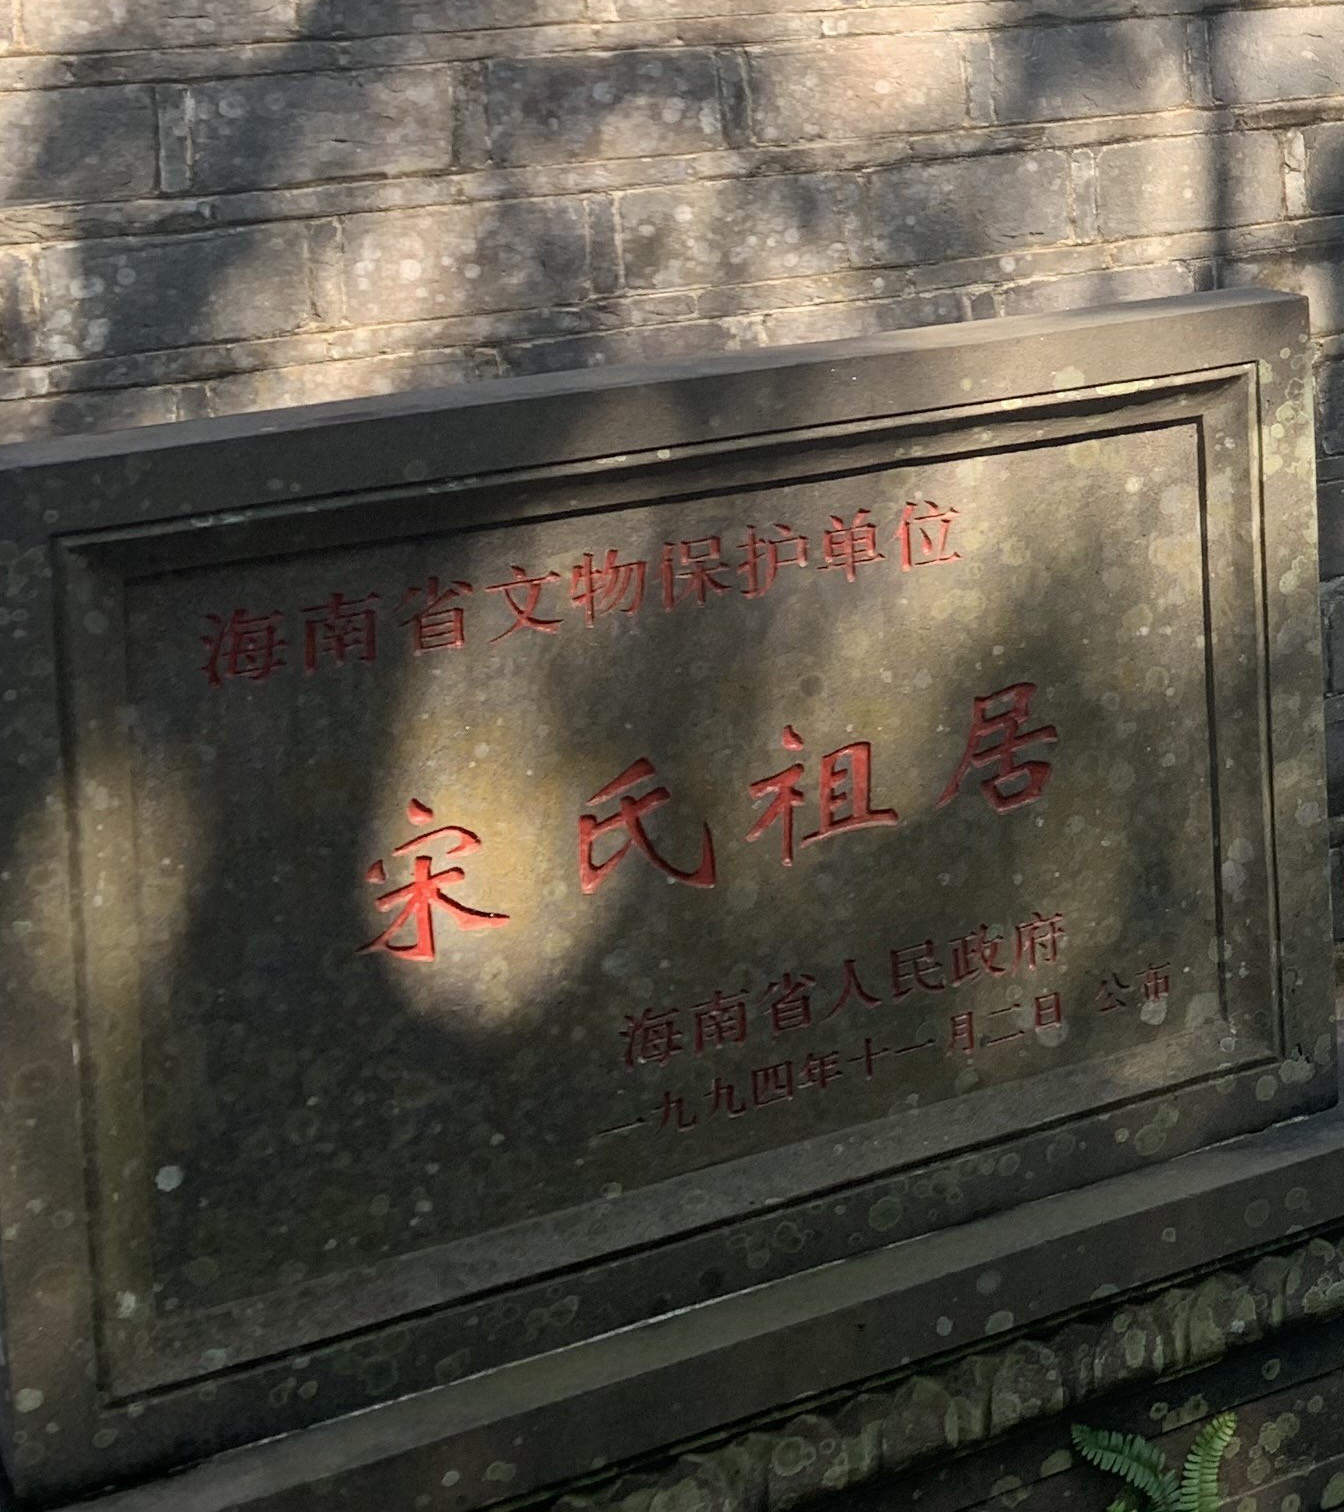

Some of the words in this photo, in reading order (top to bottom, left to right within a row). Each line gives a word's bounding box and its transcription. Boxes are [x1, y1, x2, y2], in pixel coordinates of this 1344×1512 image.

[200, 500, 962, 686] 海南省文物保护单位
[357, 682, 1061, 962] 宋氏祖居
[599, 992, 1062, 1135] 一九九四年十一月二日
[1094, 962, 1171, 1014] 公布
[618, 912, 1067, 1072] 海南省人民政府
